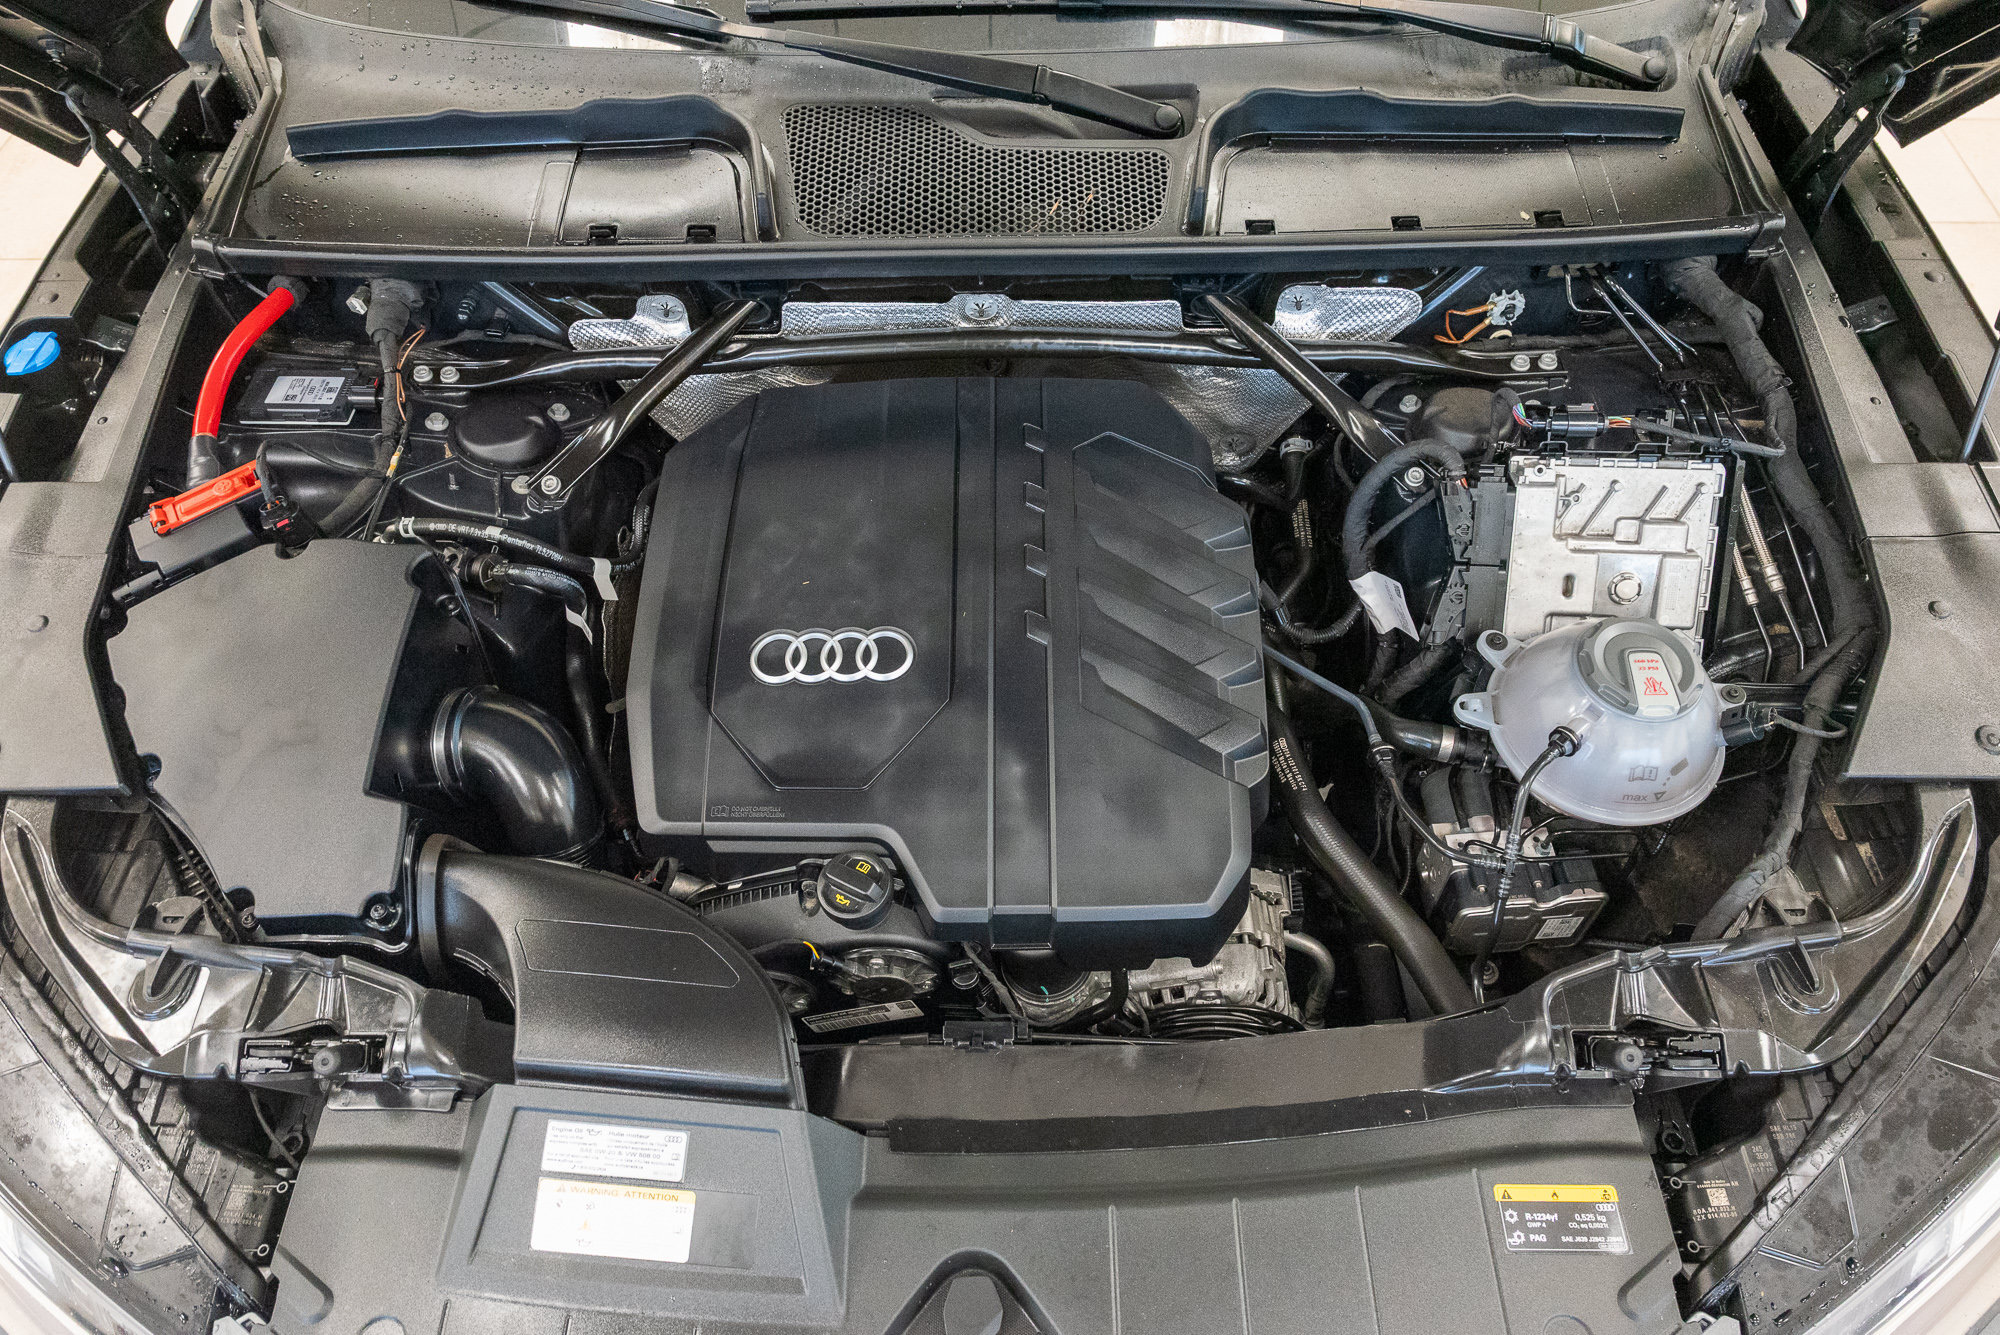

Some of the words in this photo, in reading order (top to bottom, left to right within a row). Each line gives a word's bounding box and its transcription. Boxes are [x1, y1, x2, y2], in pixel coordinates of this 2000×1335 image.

[552, 1126, 573, 1134] Engine
[570, 1186, 619, 1198] WARNING
[624, 1190, 679, 1202] ATTENTION
[1525, 1213, 1558, 1222] R-1234yf
[1574, 1213, 1595, 1222] 0,525
[1596, 1214, 1606, 1222] kg
[1529, 1234, 1547, 1242] PAG
